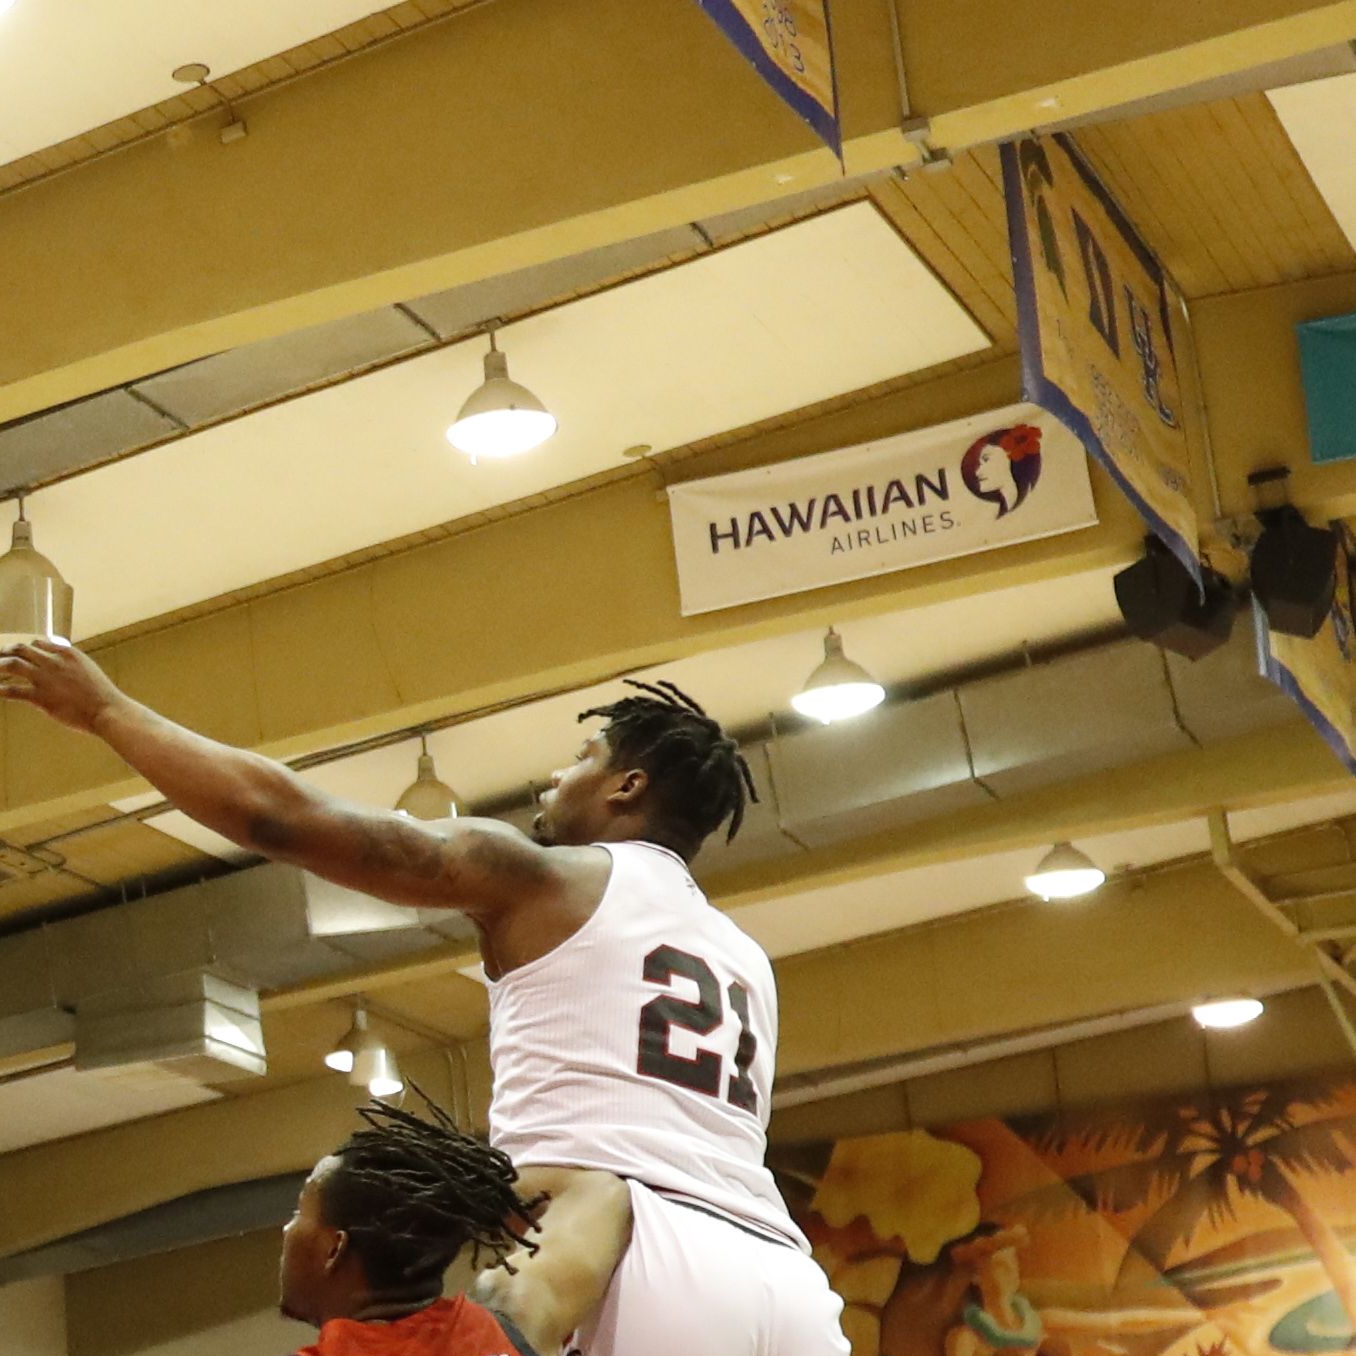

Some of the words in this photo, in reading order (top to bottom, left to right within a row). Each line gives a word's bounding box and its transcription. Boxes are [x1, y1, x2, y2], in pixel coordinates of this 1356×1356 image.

[709, 467, 951, 554] HAWAIIAN
[830, 511, 956, 555] AIRLINES
[637, 943, 759, 1115] 21
